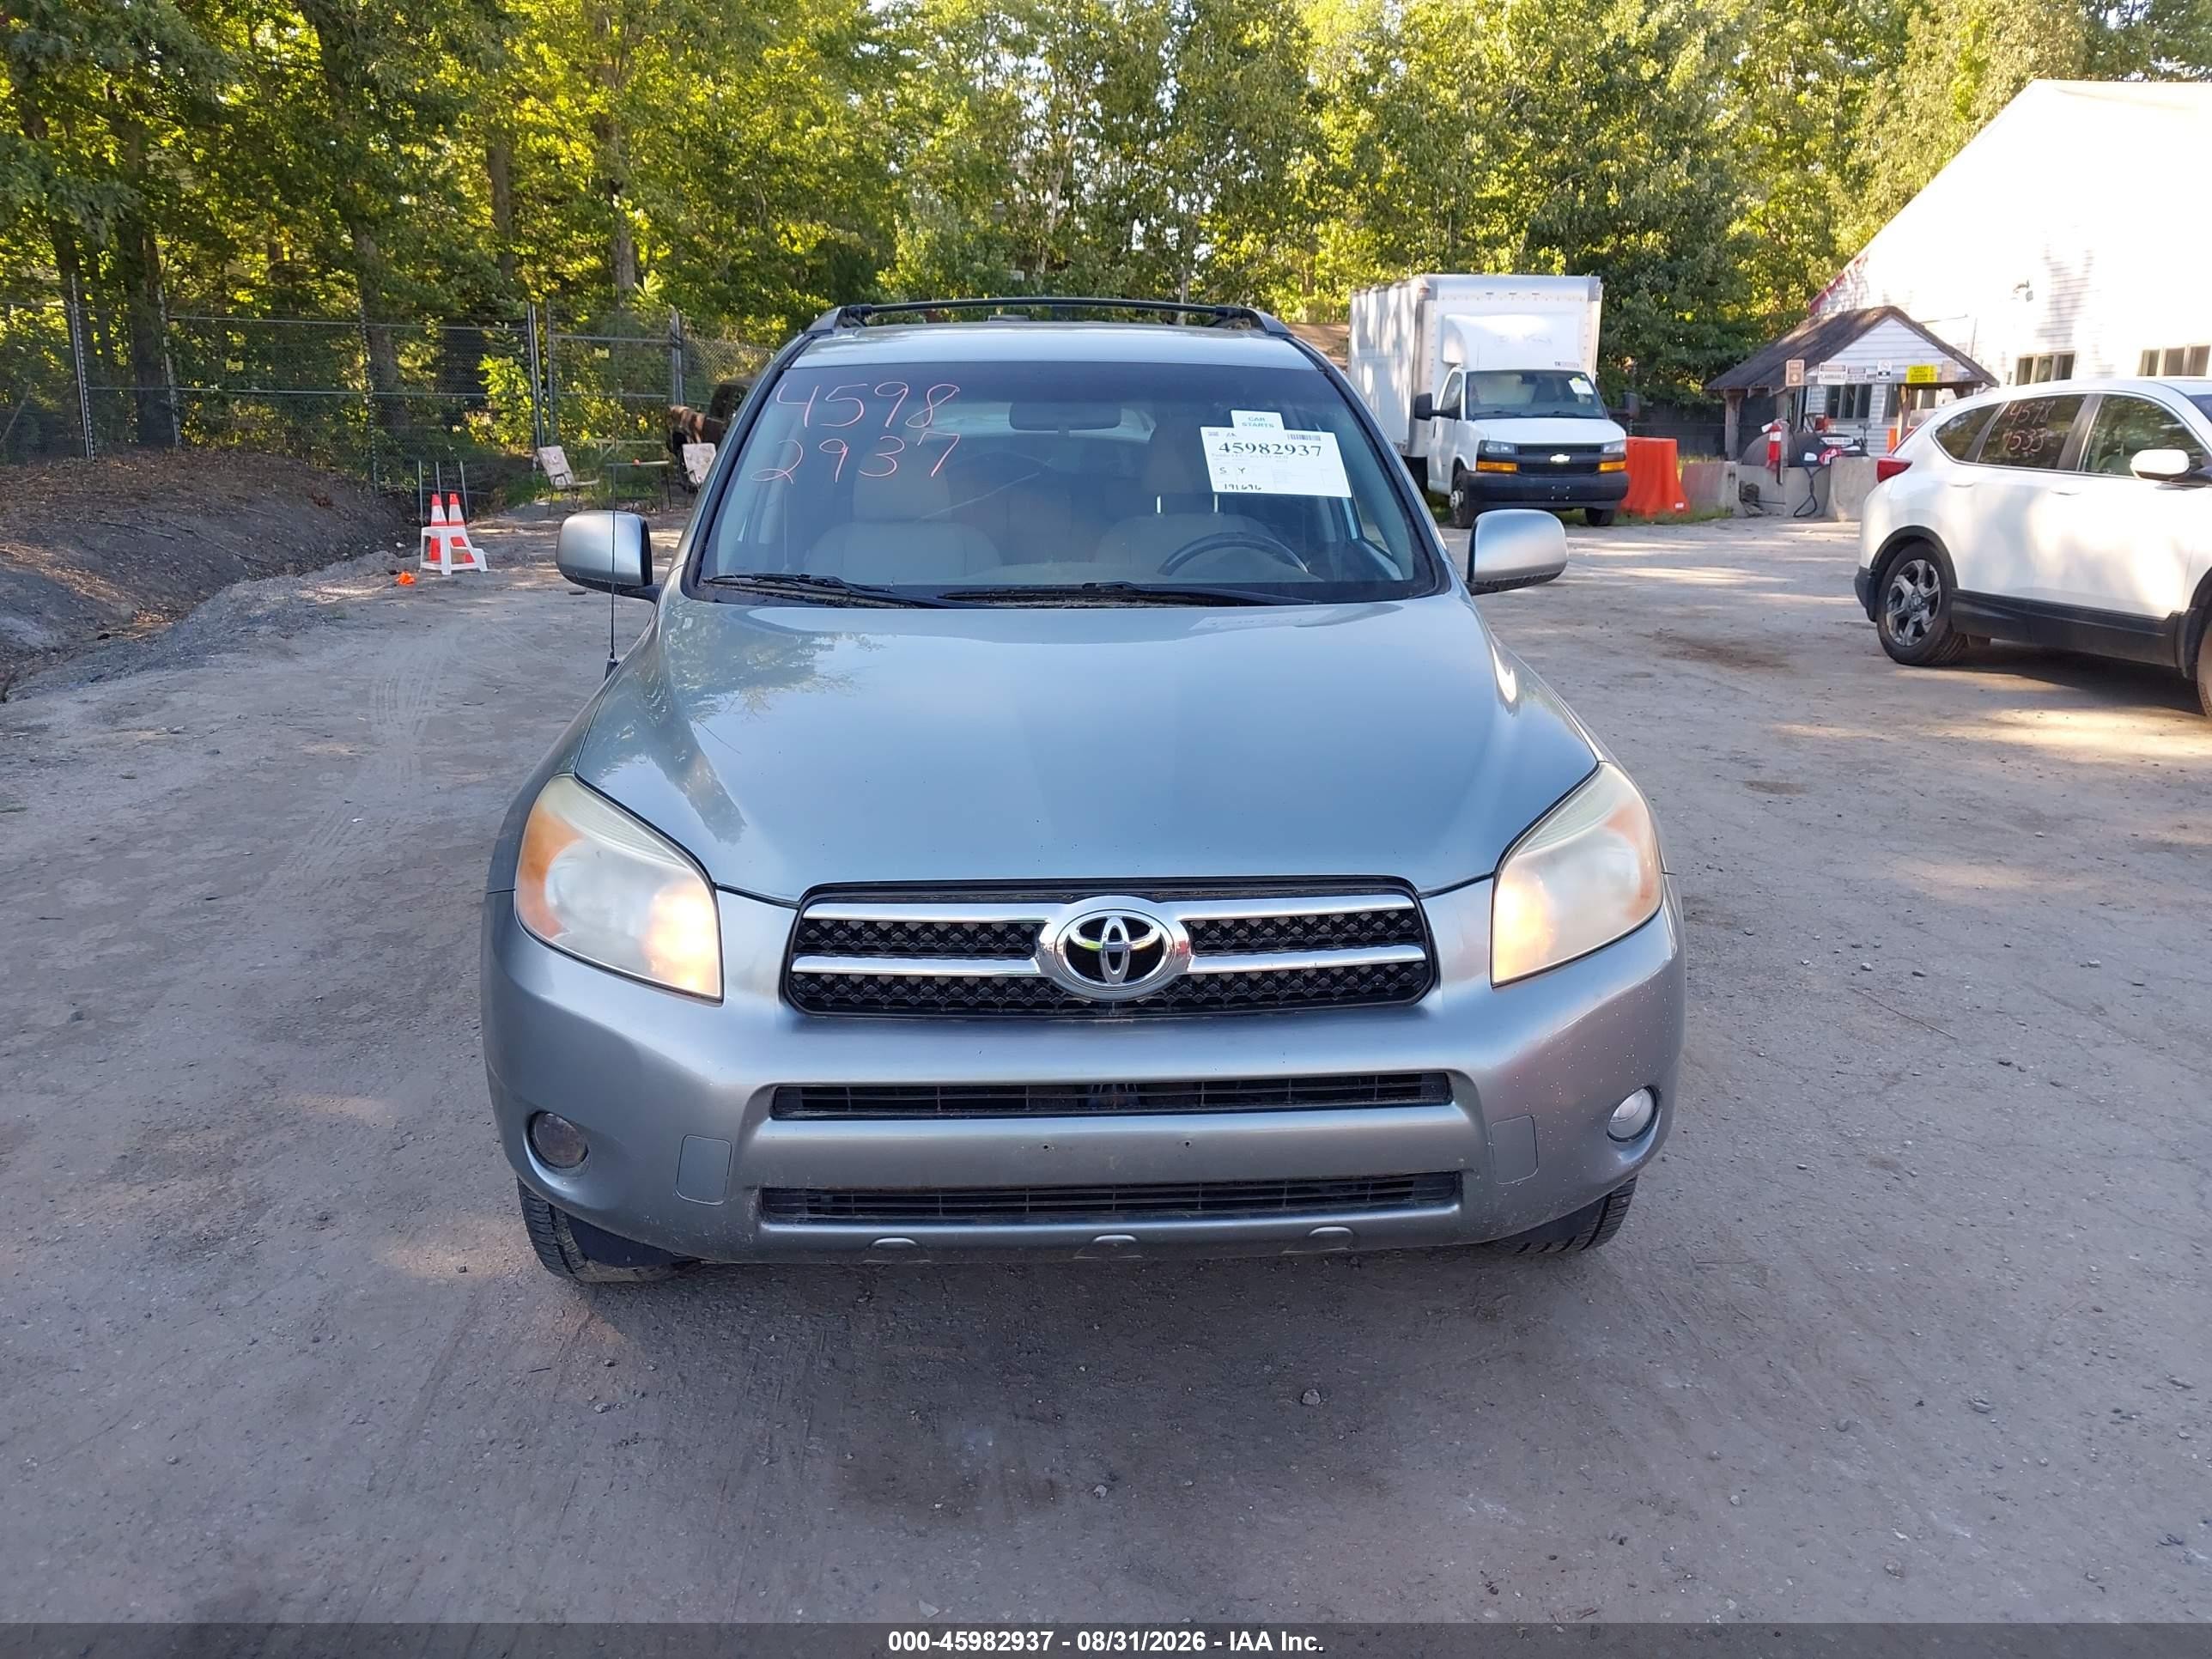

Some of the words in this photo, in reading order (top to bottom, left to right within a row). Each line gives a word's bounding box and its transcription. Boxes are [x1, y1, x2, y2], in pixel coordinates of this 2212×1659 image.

[775, 381, 961, 428] 4598
[750, 431, 961, 484] 2937
[1218, 442, 1322, 457] 45982937
